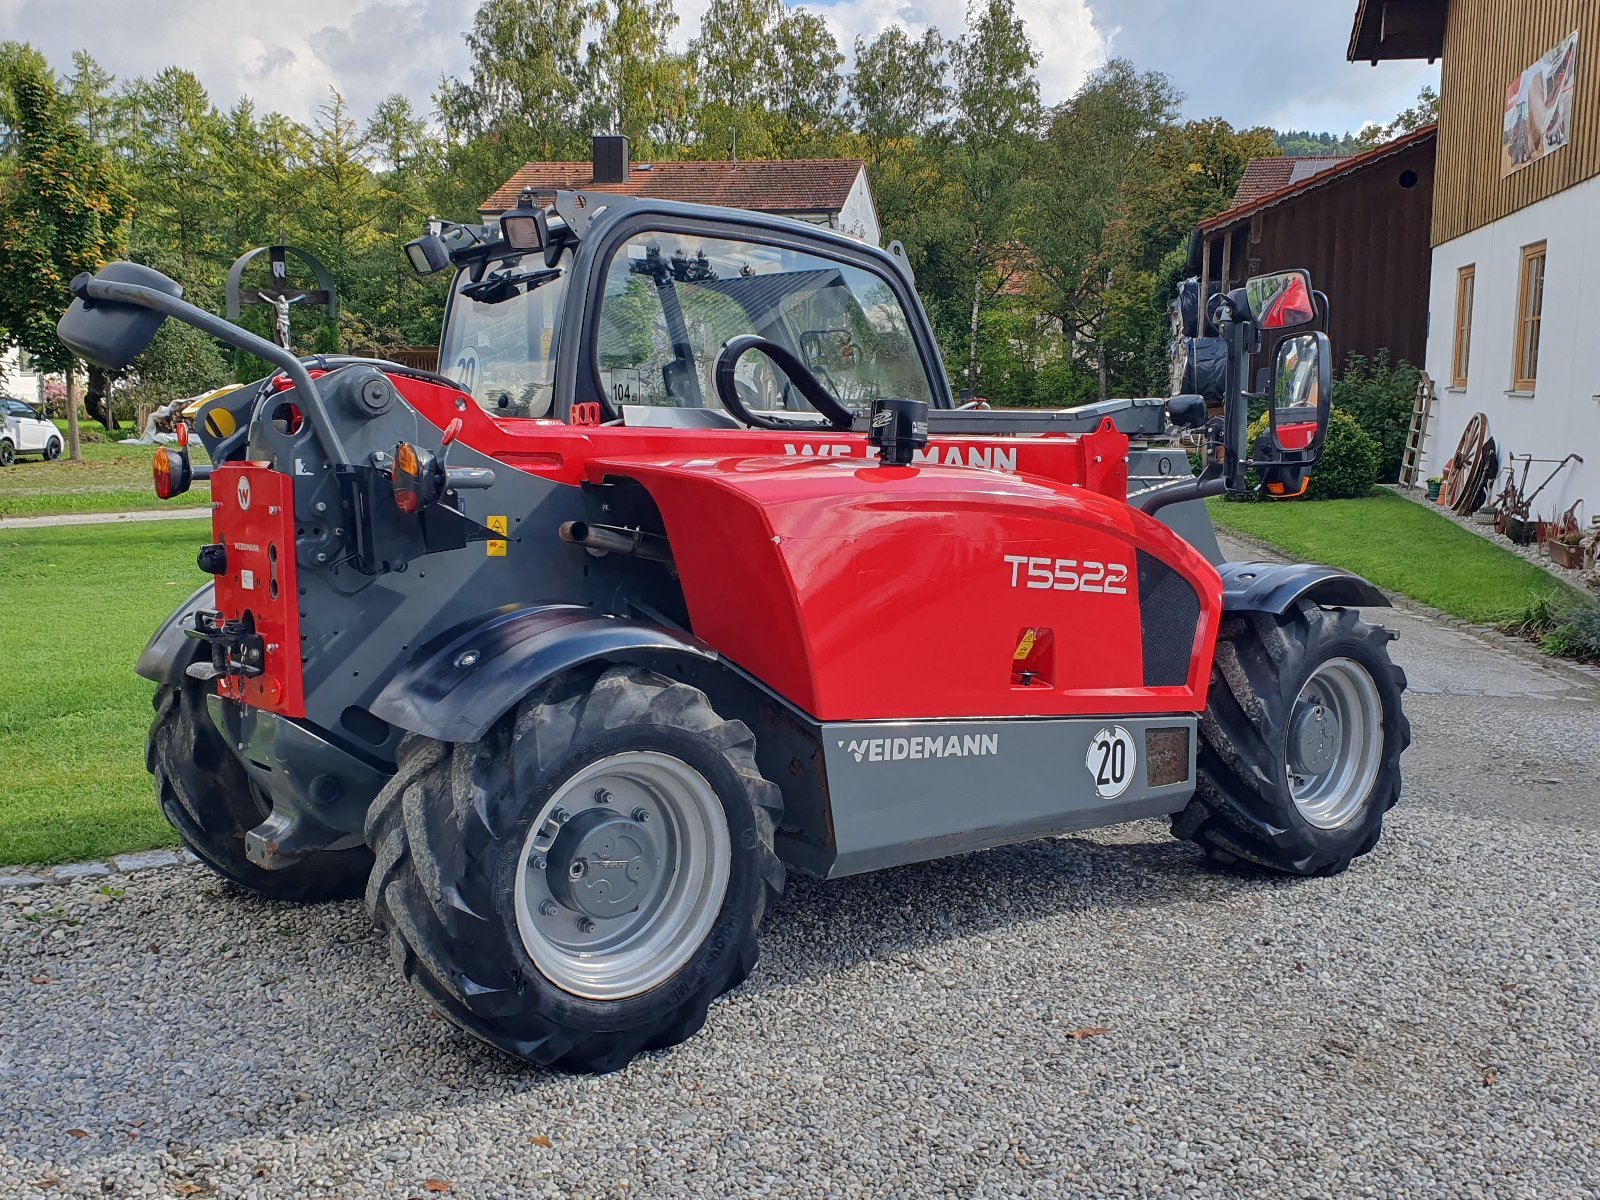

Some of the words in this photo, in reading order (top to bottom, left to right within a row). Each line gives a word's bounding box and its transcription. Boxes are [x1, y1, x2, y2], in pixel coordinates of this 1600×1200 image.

[613, 383, 631, 402] 104
[783, 443, 1017, 471] WEMANN
[1003, 554, 1128, 595] T5522
[1097, 738, 1126, 786] 20
